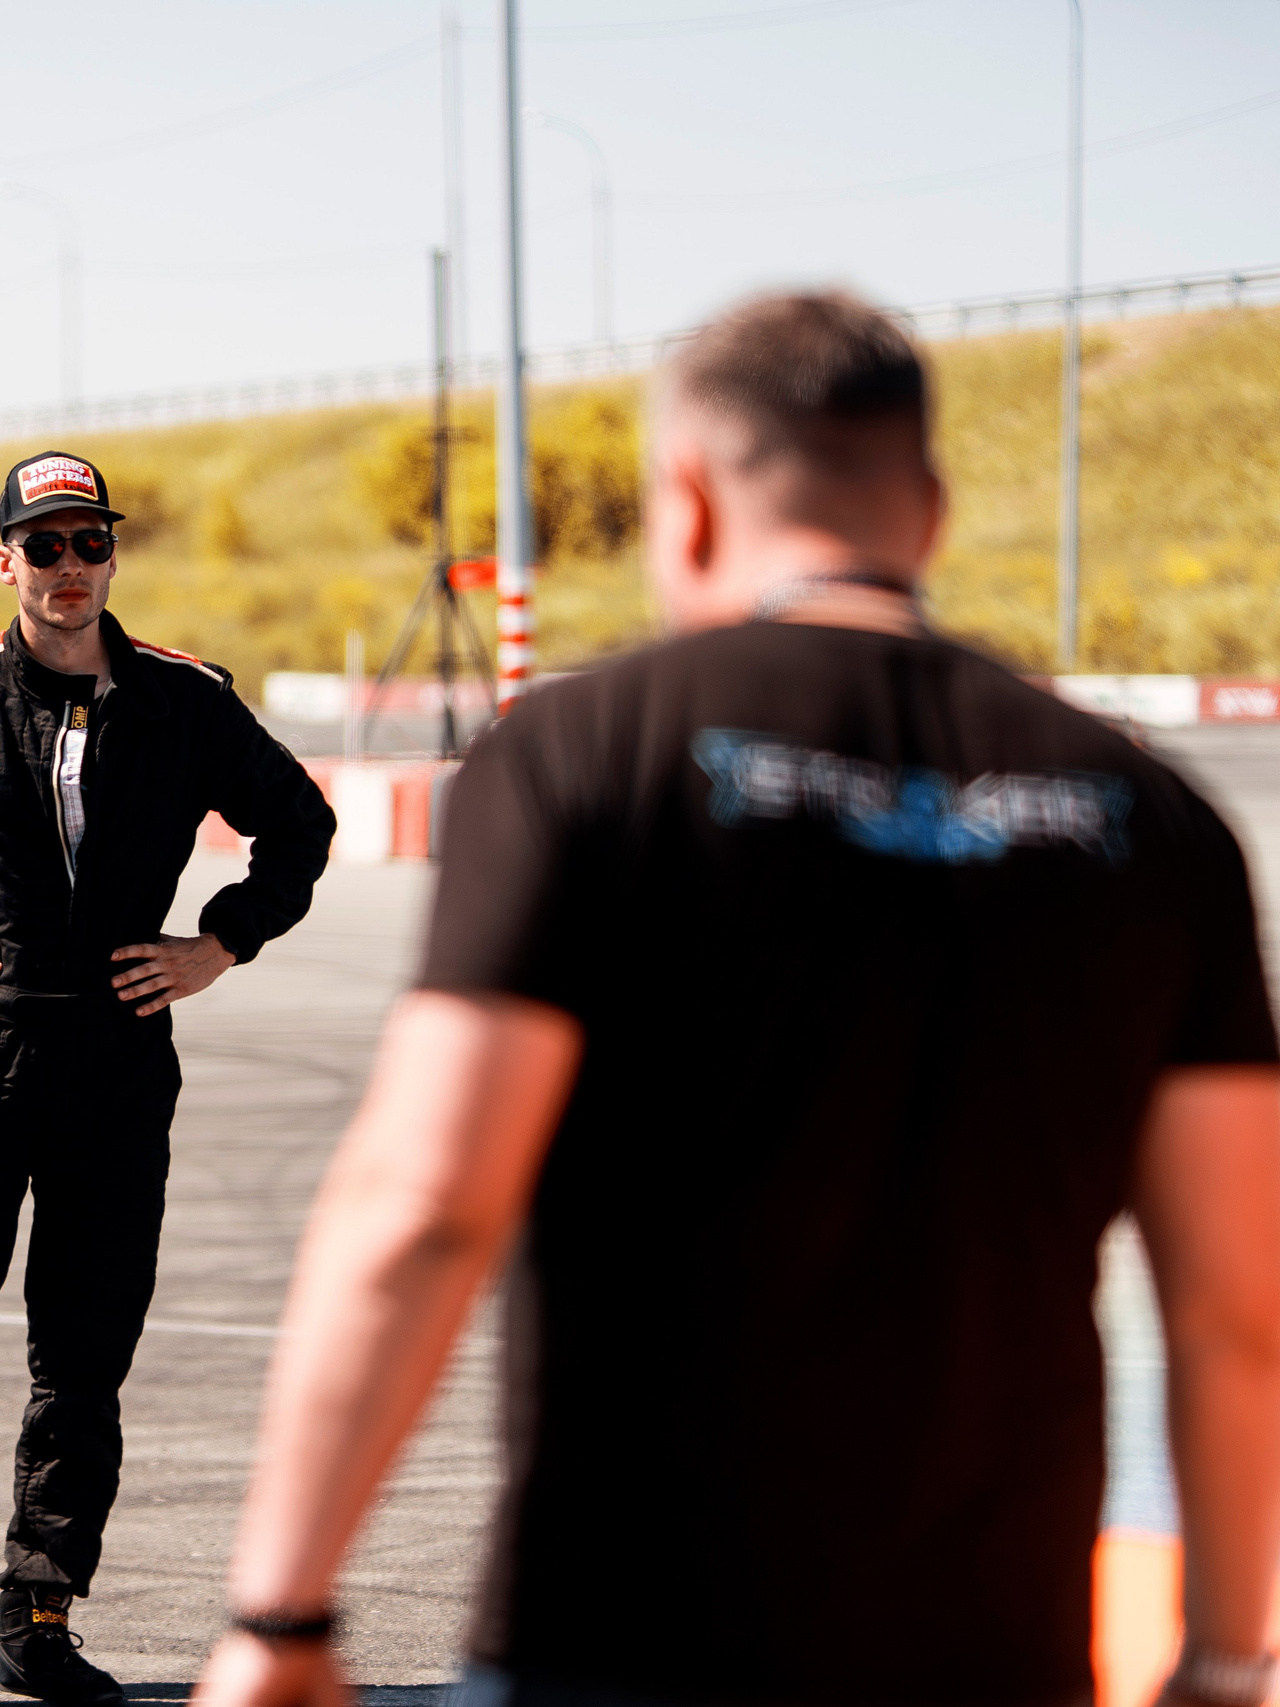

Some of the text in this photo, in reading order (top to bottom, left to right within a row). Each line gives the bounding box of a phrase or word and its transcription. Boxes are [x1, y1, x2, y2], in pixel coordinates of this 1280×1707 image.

[27, 459, 85, 477] TUNING
[23, 469, 93, 490] MASTERS
[74, 705, 87, 729] OMP
